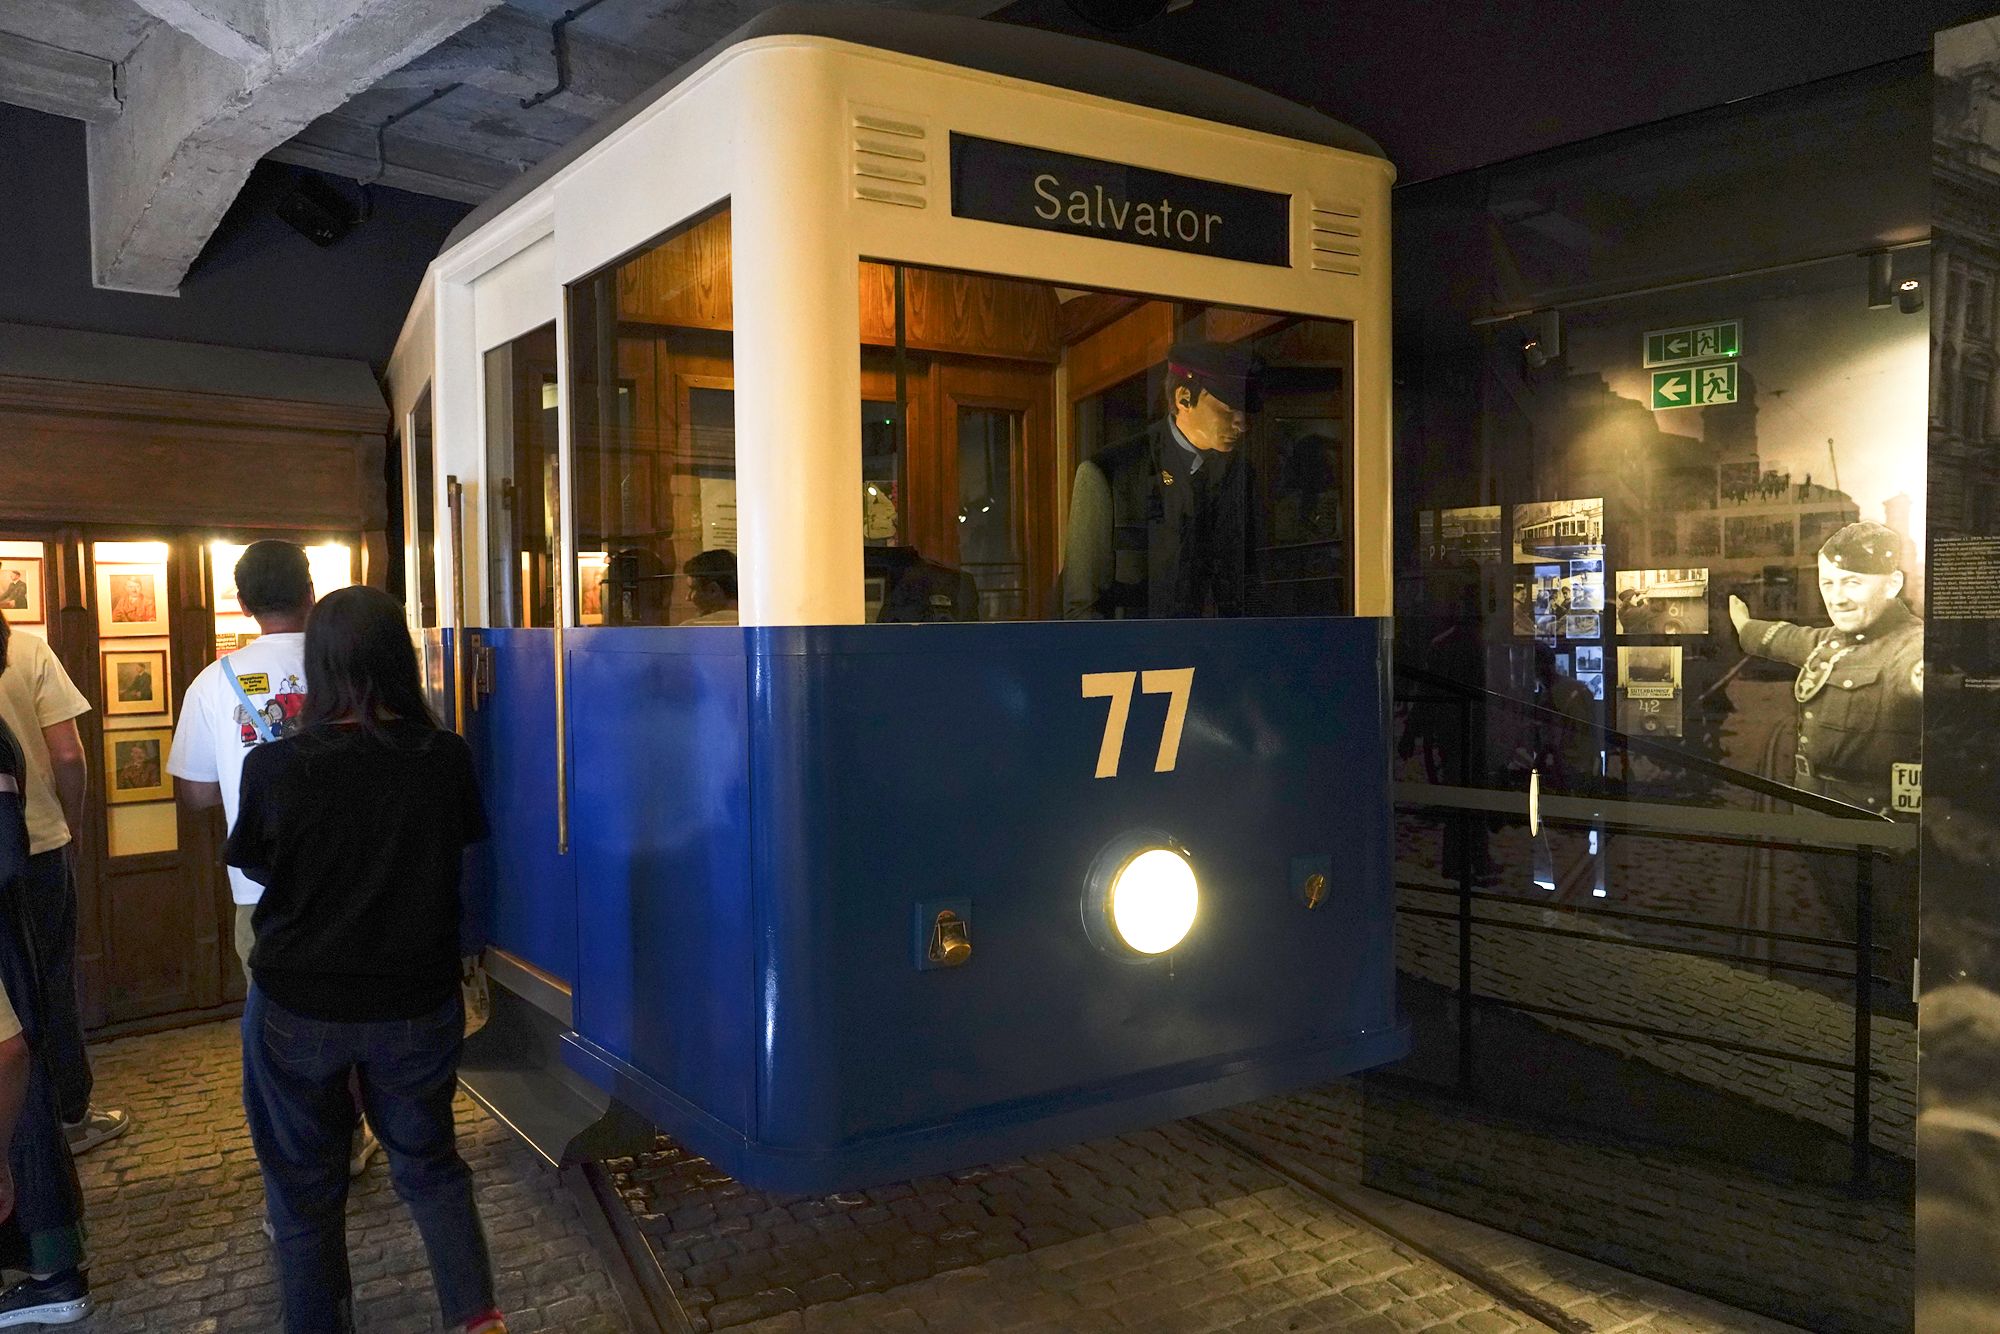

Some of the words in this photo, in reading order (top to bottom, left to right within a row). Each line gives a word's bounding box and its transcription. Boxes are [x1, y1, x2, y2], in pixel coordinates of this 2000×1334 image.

[1034, 174, 1223, 244] Salvator
[1668, 602, 1684, 617] 61
[1082, 667, 1196, 779] 77
[1639, 699, 1660, 713] 42
